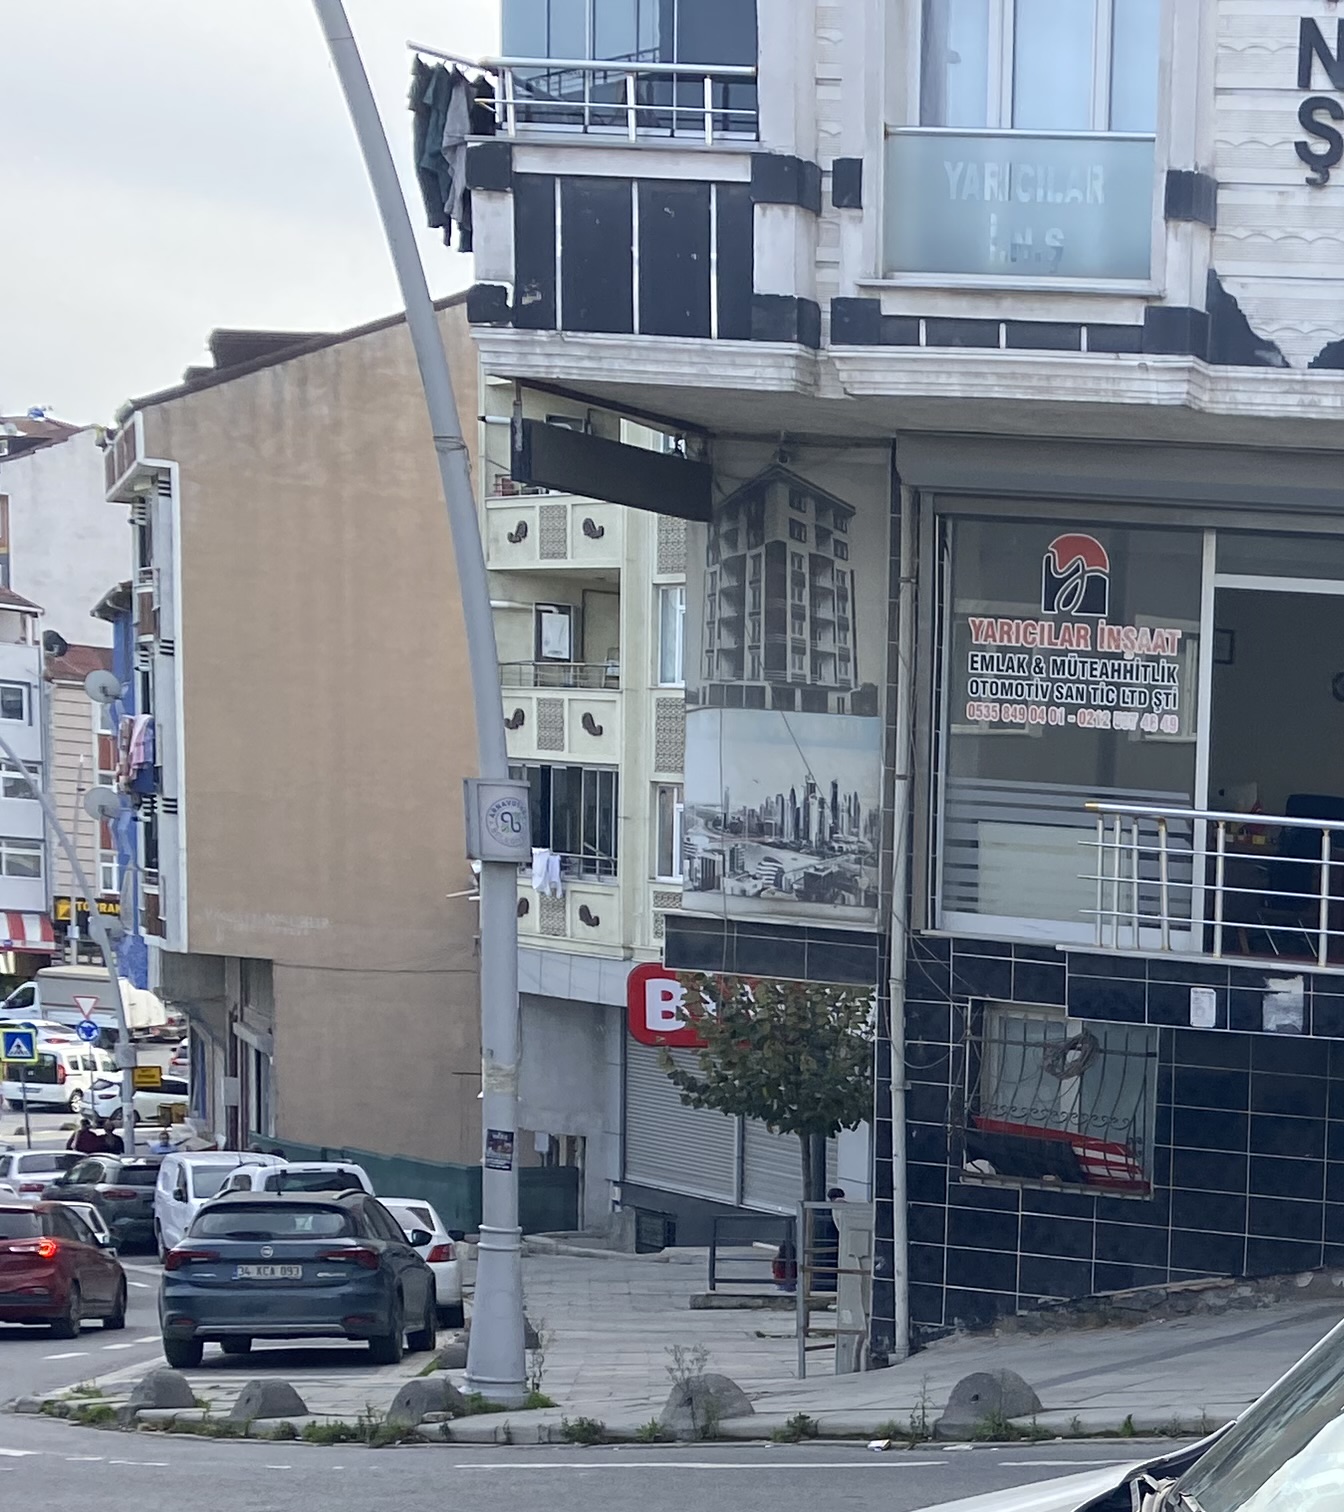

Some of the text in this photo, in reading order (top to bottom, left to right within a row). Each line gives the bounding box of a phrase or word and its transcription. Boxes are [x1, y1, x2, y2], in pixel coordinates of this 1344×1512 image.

[968, 617, 1181, 659] YARICILAR İNŞAAT
[968, 652, 1178, 685] EMLAK & MÜTEAHHİTLİK
[968, 677, 1178, 713] OTOMOTİV SAN TİC LTD ŞTİ
[966, 702, 1000, 721] 0535
[1001, 703, 1027, 722] 849
[1029, 704, 1047, 724] 04
[1049, 706, 1065, 725] 01
[1077, 708, 1111, 728] 0212
